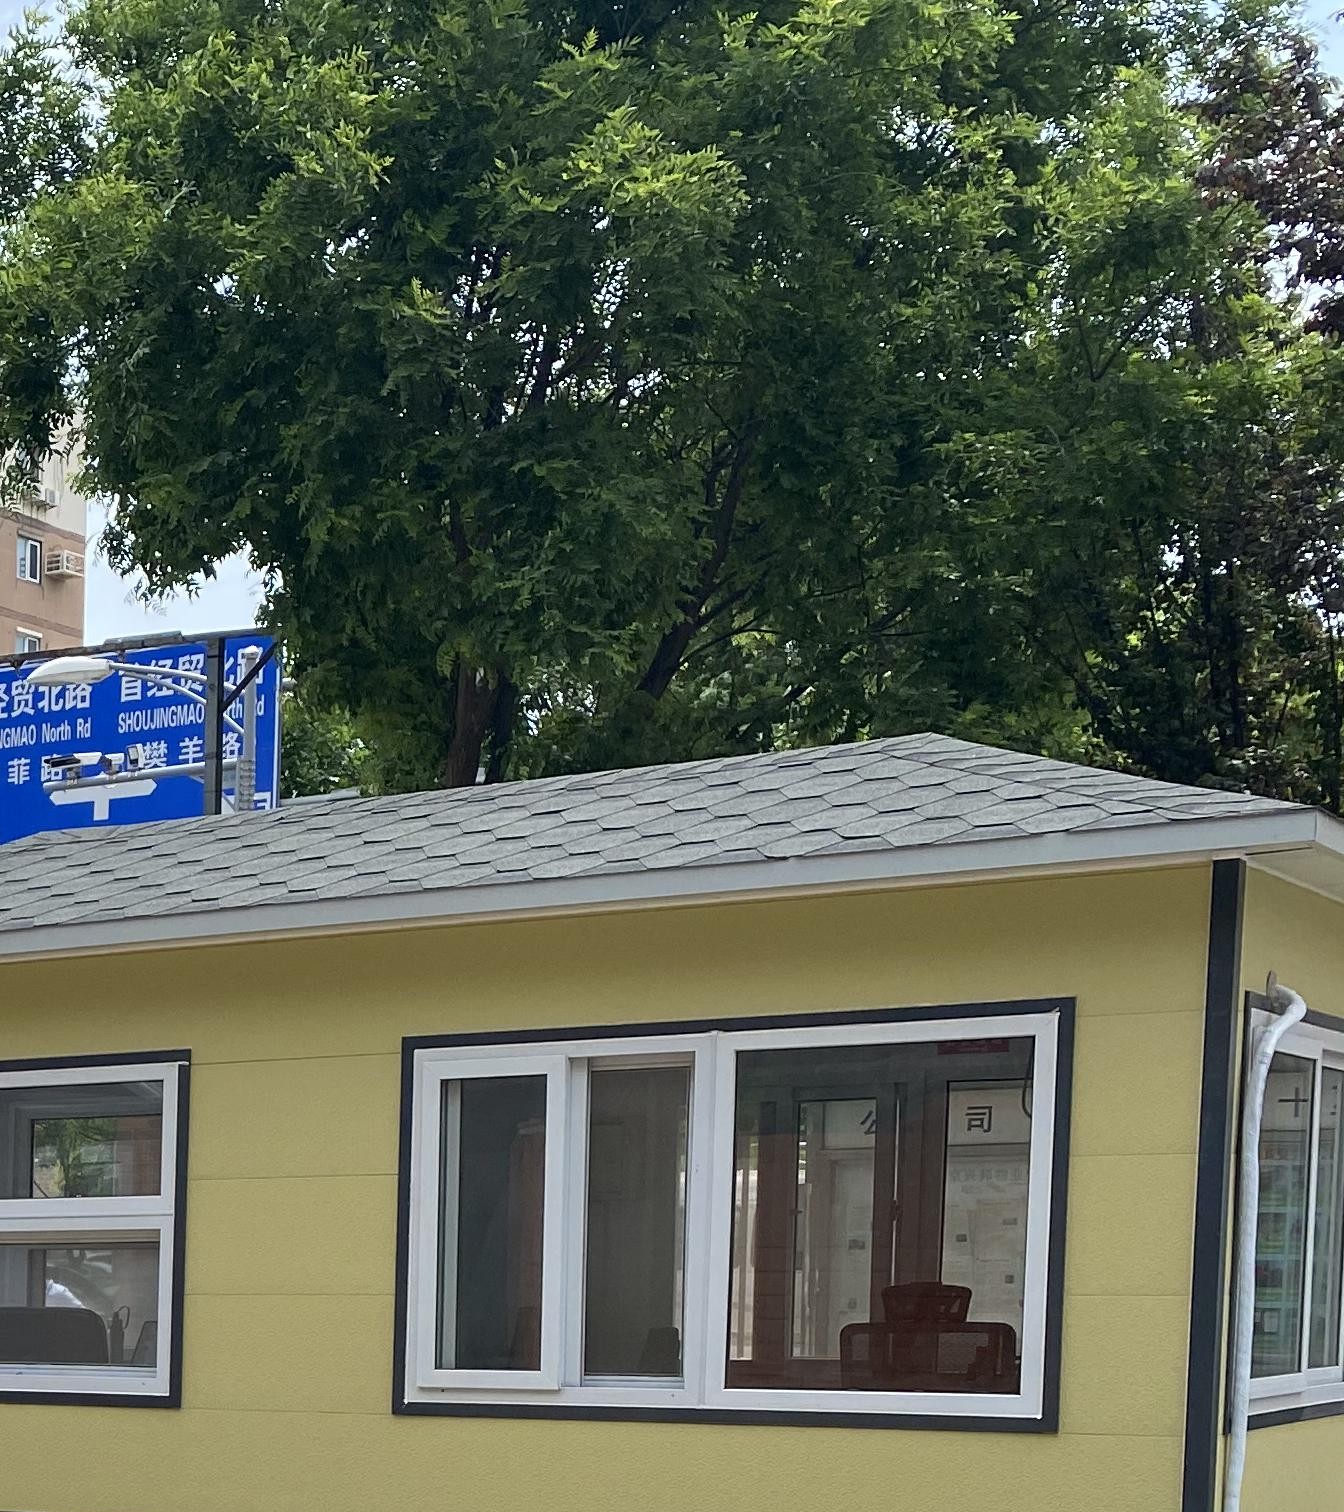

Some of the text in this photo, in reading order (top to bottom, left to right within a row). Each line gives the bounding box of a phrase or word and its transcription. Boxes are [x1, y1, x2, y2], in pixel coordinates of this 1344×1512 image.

[40, 725, 72, 744] North
[76, 717, 92, 739] Rd
[118, 703, 205, 735] SHOUJINGMAO
